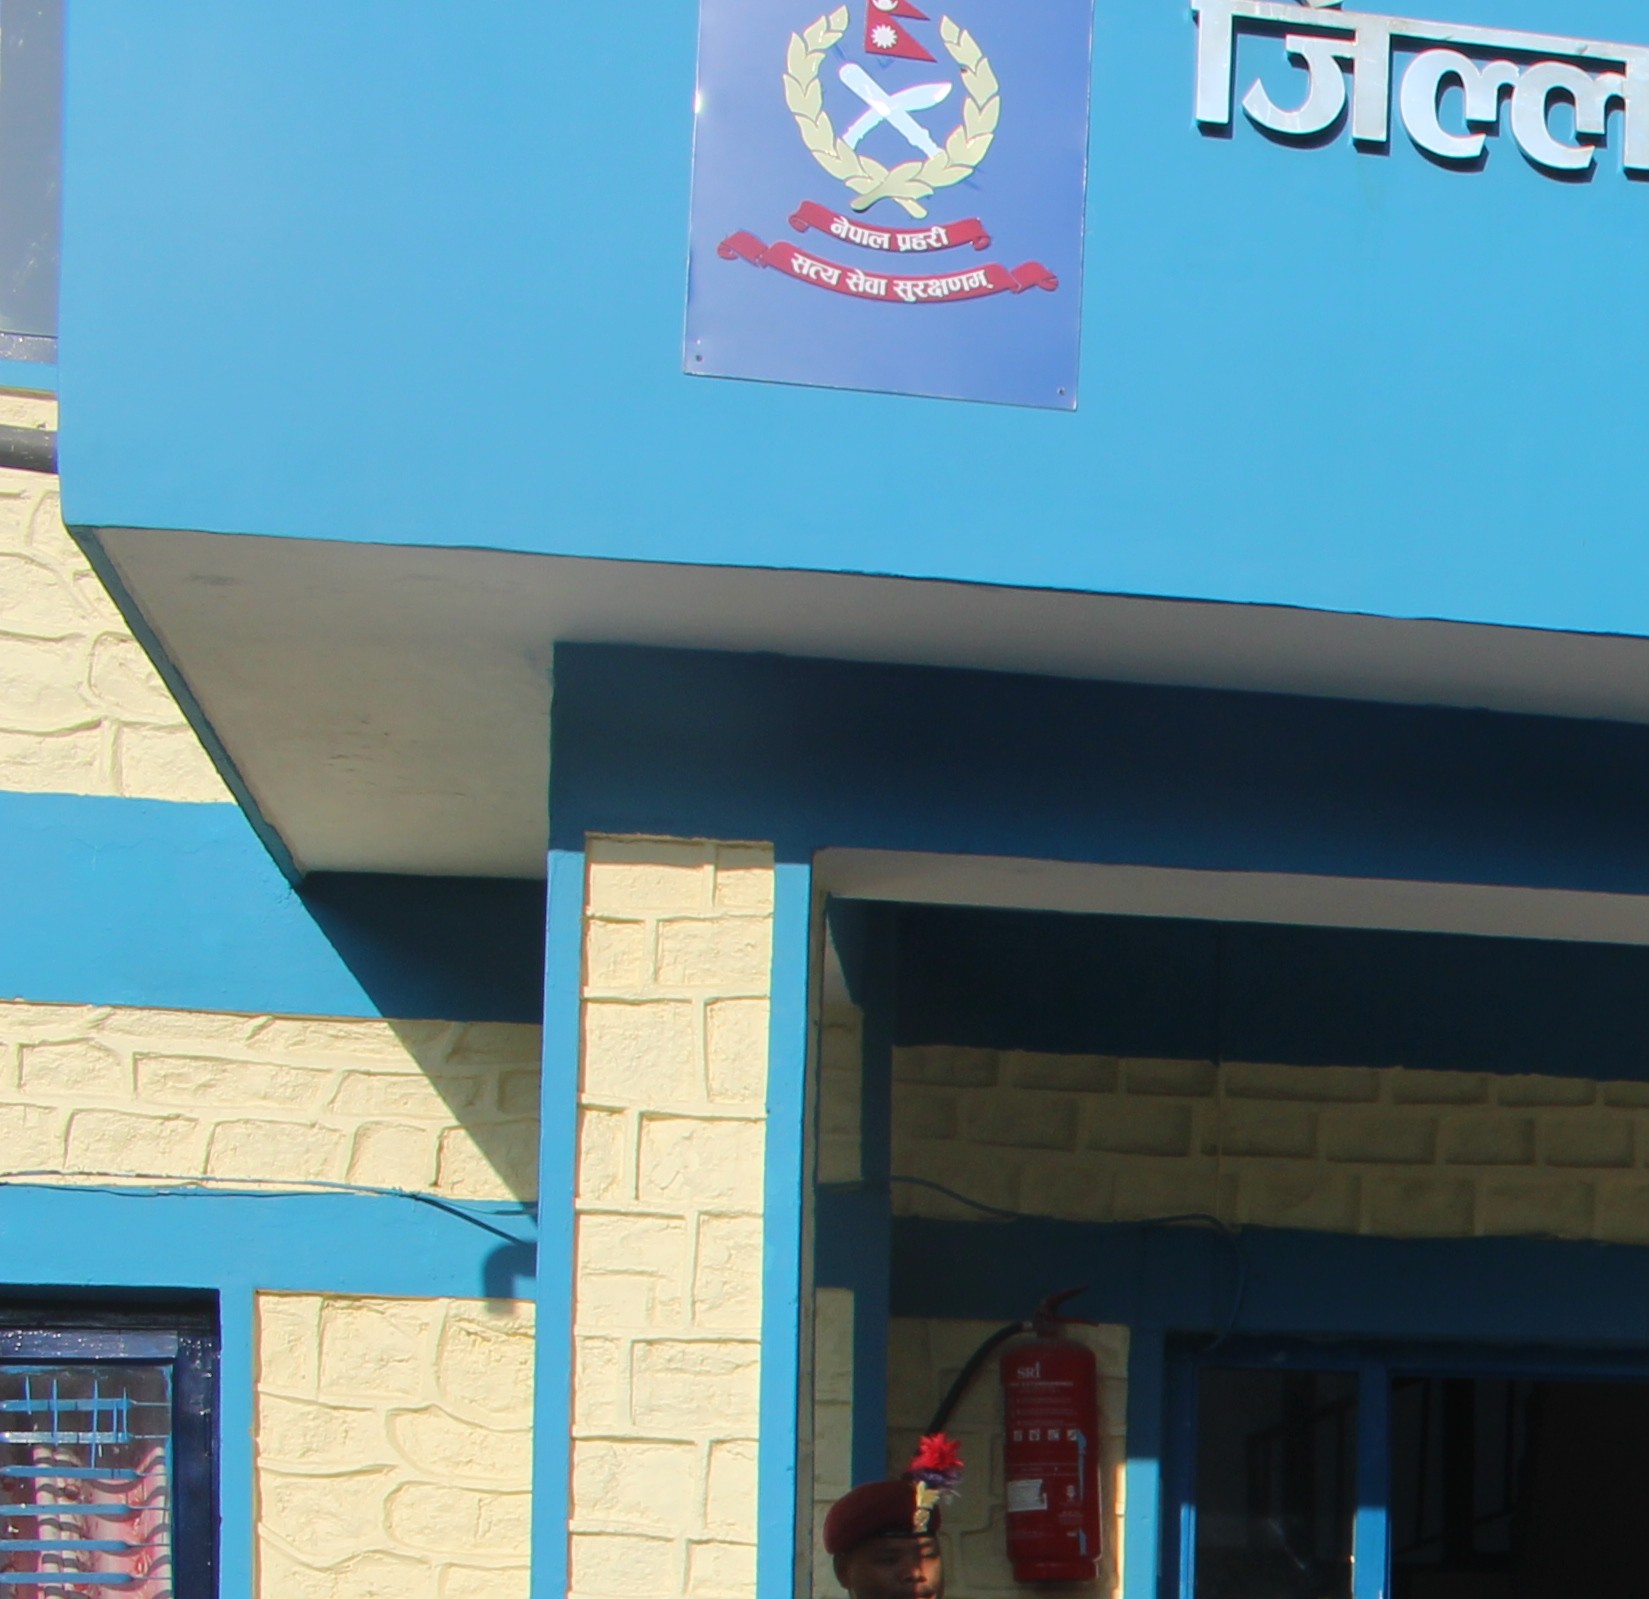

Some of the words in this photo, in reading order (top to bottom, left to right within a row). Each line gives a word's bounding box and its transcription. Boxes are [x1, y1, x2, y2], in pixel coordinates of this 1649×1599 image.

[830, 216, 890, 249] नेपाल
[896, 226, 949, 252] प्रहरी
[791, 252, 842, 285] सत्य
[846, 268, 888, 296] सेवा
